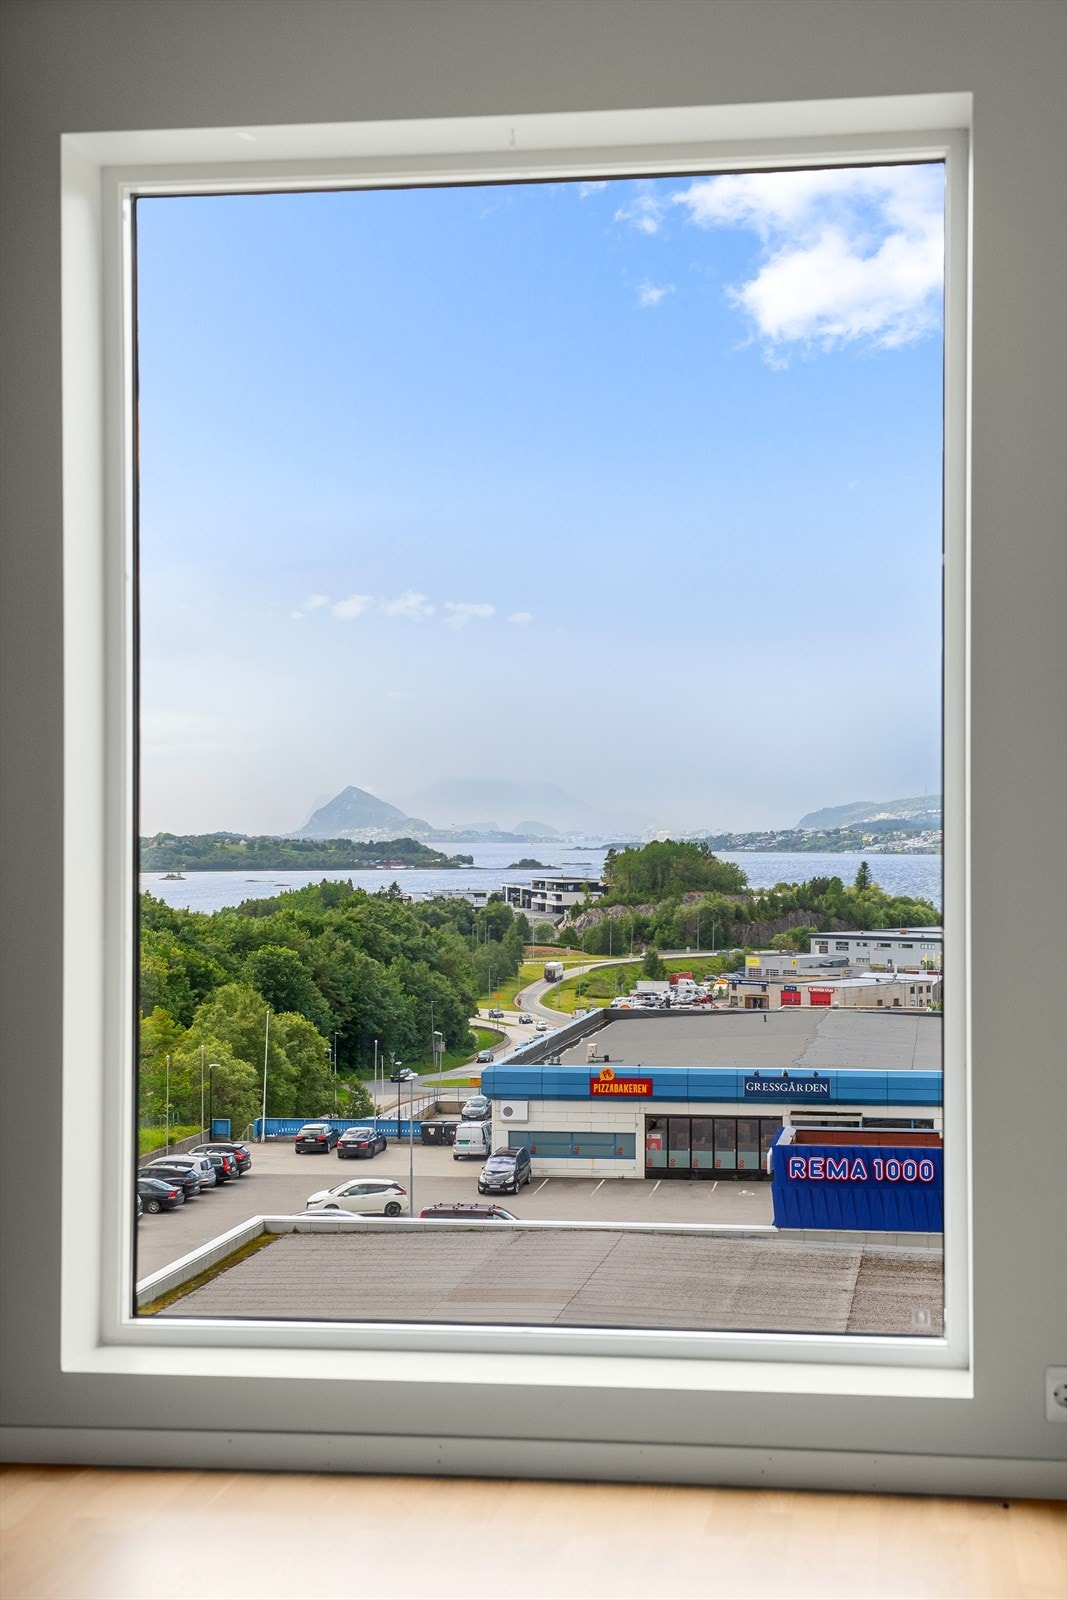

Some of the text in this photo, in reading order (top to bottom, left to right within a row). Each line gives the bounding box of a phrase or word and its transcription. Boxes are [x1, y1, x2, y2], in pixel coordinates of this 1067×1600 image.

[593, 1083, 648, 1093] PIZZABAKEREN
[745, 1081, 828, 1093] GRESSGÅRDEN
[788, 1156, 935, 1183] REMA 1000
